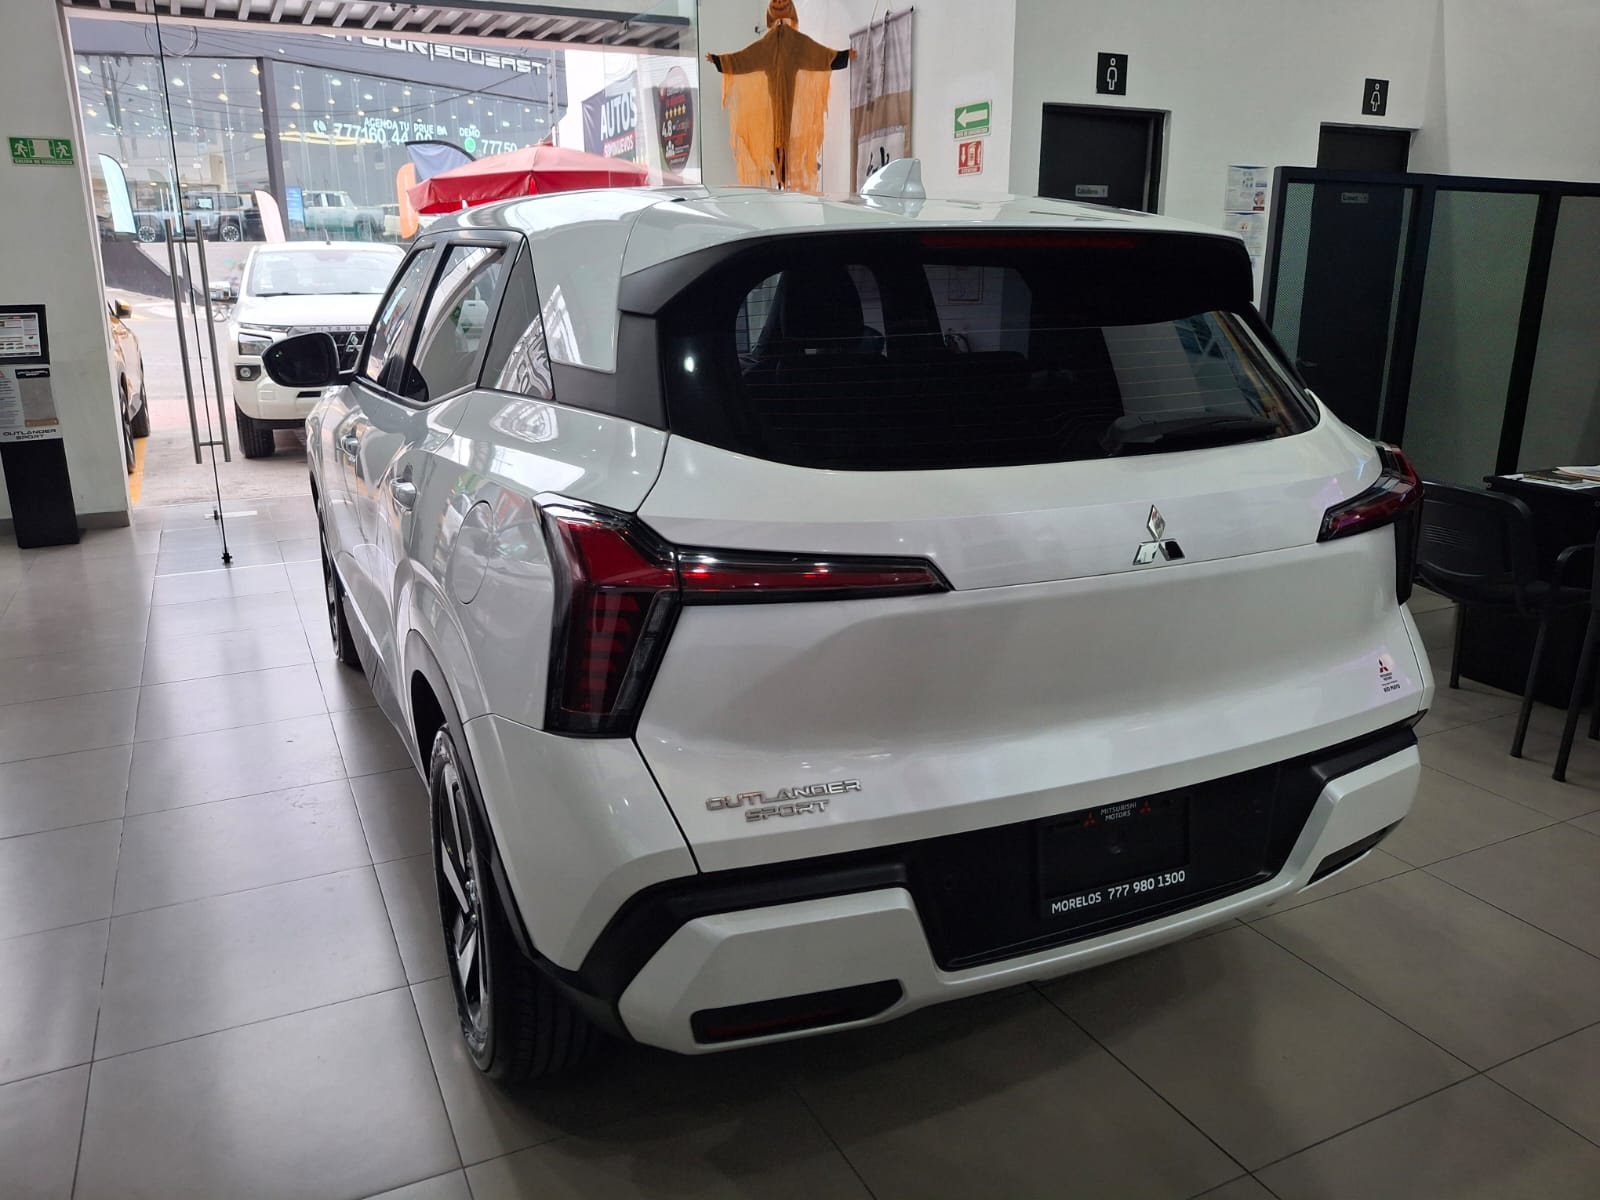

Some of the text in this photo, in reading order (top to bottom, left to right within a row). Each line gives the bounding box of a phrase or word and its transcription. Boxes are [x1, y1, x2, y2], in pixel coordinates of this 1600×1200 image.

[601, 88, 637, 141] AUTOS
[364, 117, 397, 131] AGENDA
[399, 121, 410, 132] TU
[459, 127, 480, 138] DEMO
[661, 119, 673, 137] 4.8
[3, 428, 57, 437] OUTLANDER
[705, 778, 862, 811] OUTLANDER
[745, 799, 829, 822] SPORT
[1100, 801, 1136, 815] MITSUBISHI
[1105, 810, 1131, 821] MOTORS
[1051, 870, 1186, 914] MORELOS 777 980 1300
